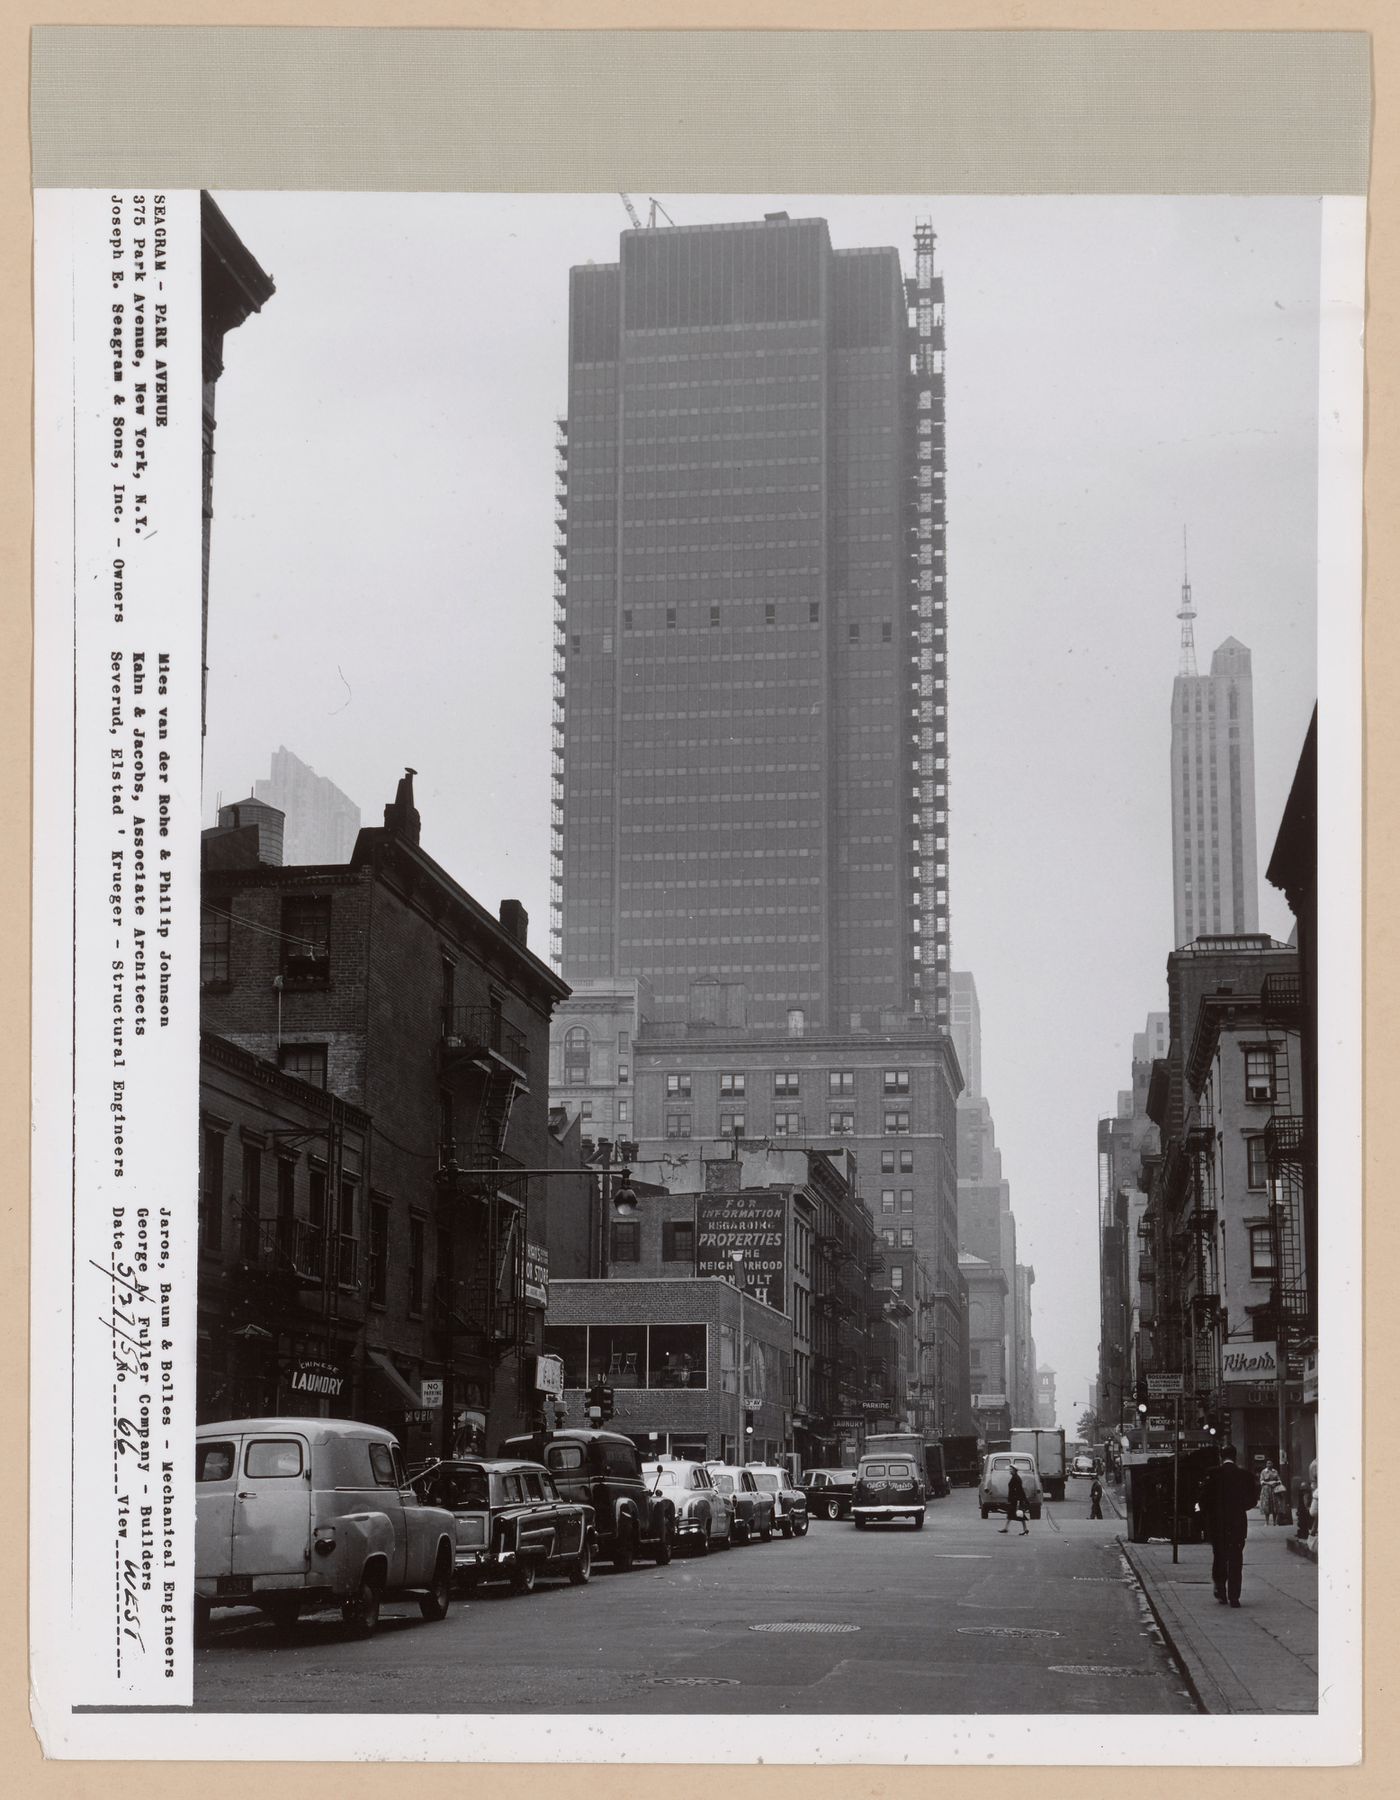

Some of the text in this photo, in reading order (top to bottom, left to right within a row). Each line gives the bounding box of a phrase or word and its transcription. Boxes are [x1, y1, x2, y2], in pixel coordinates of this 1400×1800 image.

[109, 194, 125, 260] Joseph
[153, 195, 167, 271] SEAGRAM
[111, 270, 124, 289] E.
[109, 303, 125, 382] Seagram
[154, 303, 168, 349] PARK
[131, 195, 148, 534] 375 Park Avenue, New York, N.Y.
[155, 359, 168, 427] AVENUE
[113, 394, 126, 406] &
[110, 416, 126, 469] Sons,
[113, 484, 126, 523] Inc.
[112, 558, 126, 623] Owners
[108, 651, 124, 735] Severud,
[110, 748, 125, 815] Elstad
[131, 651, 147, 1036] Kahn & Jacobs, Associate Architects
[156, 652, 172, 1028] Mies van der Rohe & Philip Johnson
[108, 850, 124, 927] Krueger
[111, 960, 126, 1067] Structural
[109, 1080, 126, 1178] Engineers
[112, 1206, 125, 1250] Date
[702, 1209, 782, 1218] INFORMATION
[725, 1199, 757, 1208] FOR
[134, 1207, 150, 1273] George
[157, 1207, 172, 1269] Jaros,
[698, 1233, 782, 1247] PROPERTIES
[699, 1261, 783, 1271] NEIGHRHOOD
[160, 1282, 172, 1328] Baum
[710, 1275, 772, 1285] ONULT
[116, 1362, 128, 1383] No
[138, 1316, 152, 1383] Fuller
[161, 1339, 173, 1351] &
[299, 1359, 341, 1374] CHINESE
[160, 1360, 174, 1426] Bolles
[291, 1371, 345, 1396] LAUNDRY
[117, 1417, 140, 1455] 66
[136, 1394, 152, 1473] Company
[117, 1495, 129, 1539] View
[161, 1461, 176, 1568] Mechanical
[140, 1505, 153, 1591] Builders
[123, 1559, 146, 1653] WEST
[160, 1581, 176, 1678] Engineers
